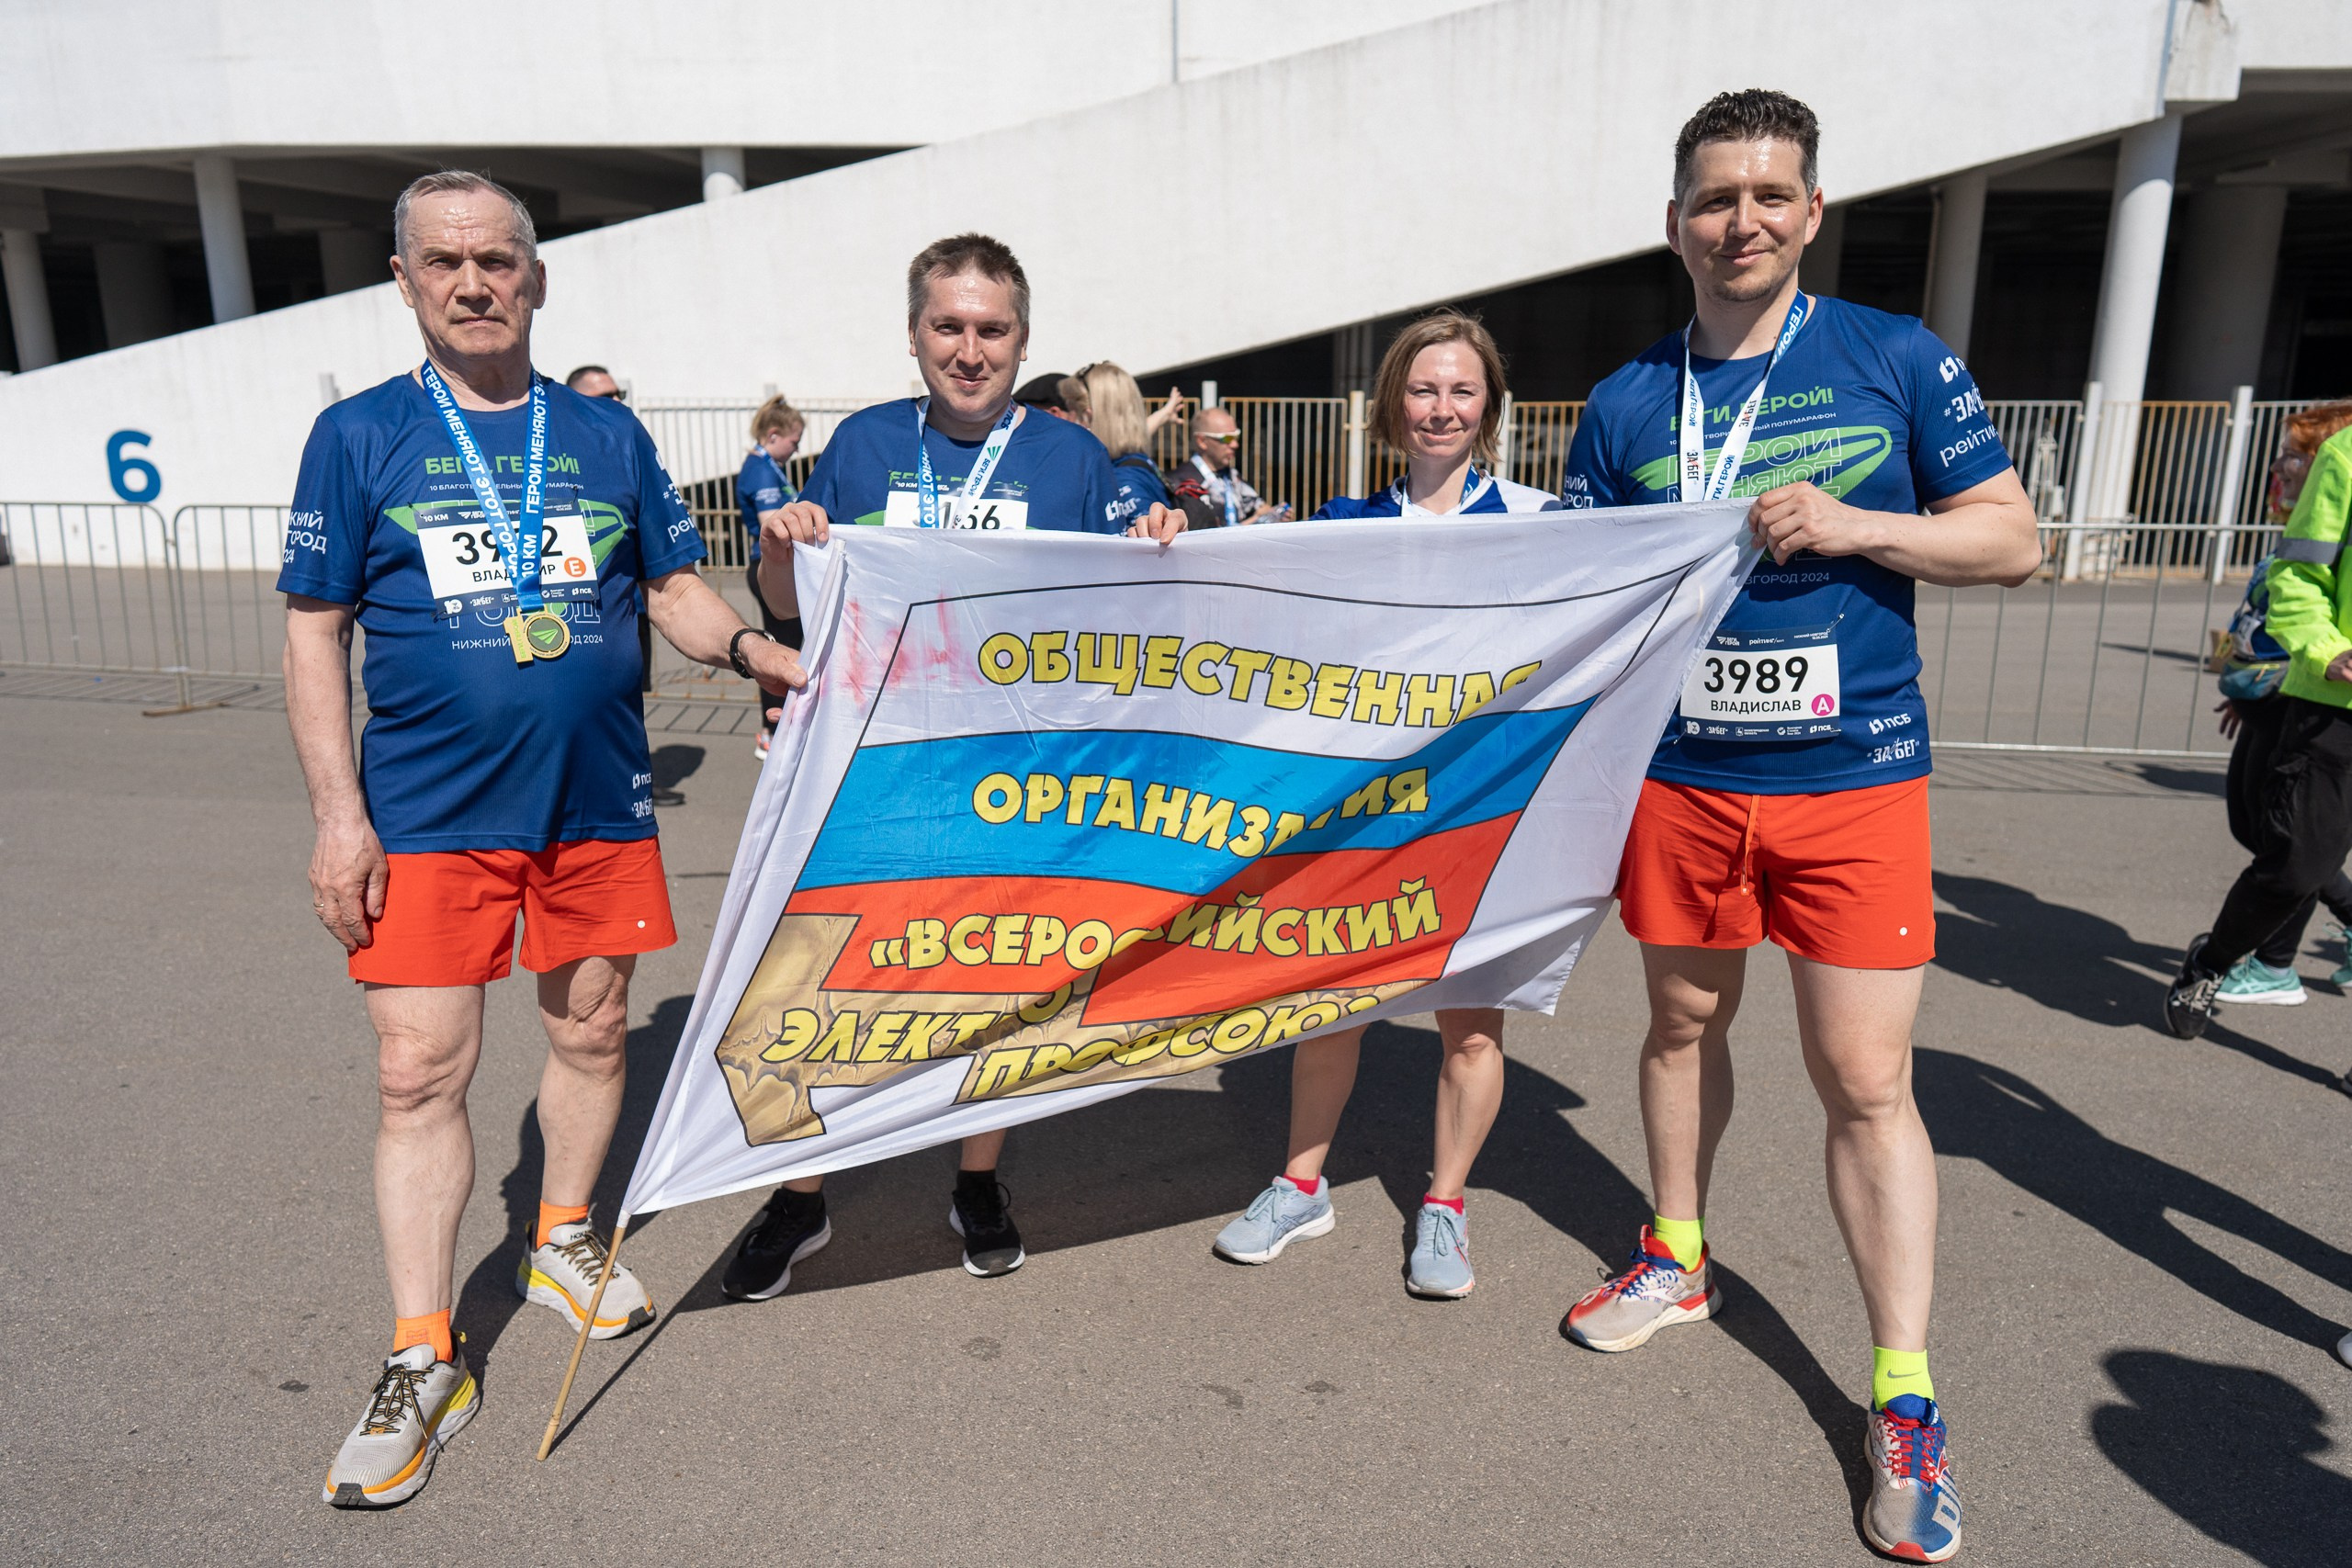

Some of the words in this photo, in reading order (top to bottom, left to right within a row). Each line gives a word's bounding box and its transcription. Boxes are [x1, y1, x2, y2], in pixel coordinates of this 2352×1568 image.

[1777, 305, 1804, 357] ГЕРОИ
[423, 366, 453, 409] ГЕРОИ
[443, 409, 485, 474] МЕНЯЮТ
[476, 478, 505, 521] ЭТОТ
[530, 400, 547, 461] МЕНЯЮТ
[107, 430, 162, 503] 6
[526, 463, 543, 513] ГЕРОИ
[452, 525, 563, 565] 392
[472, 564, 557, 582] ВЛАДИР
[1801, 571, 1830, 582] 2024
[452, 636, 512, 650] НИЖНИЙ
[583, 634, 603, 644] 2024
[1704, 656, 1809, 694] 3989
[1711, 699, 1802, 715] ВЛАДИСЛАВ
[1883, 713, 1912, 728] ПСБ
[972, 766, 1430, 859] ОРГАНИЗАИЯ
[571, 1232, 586, 1241] HOK
